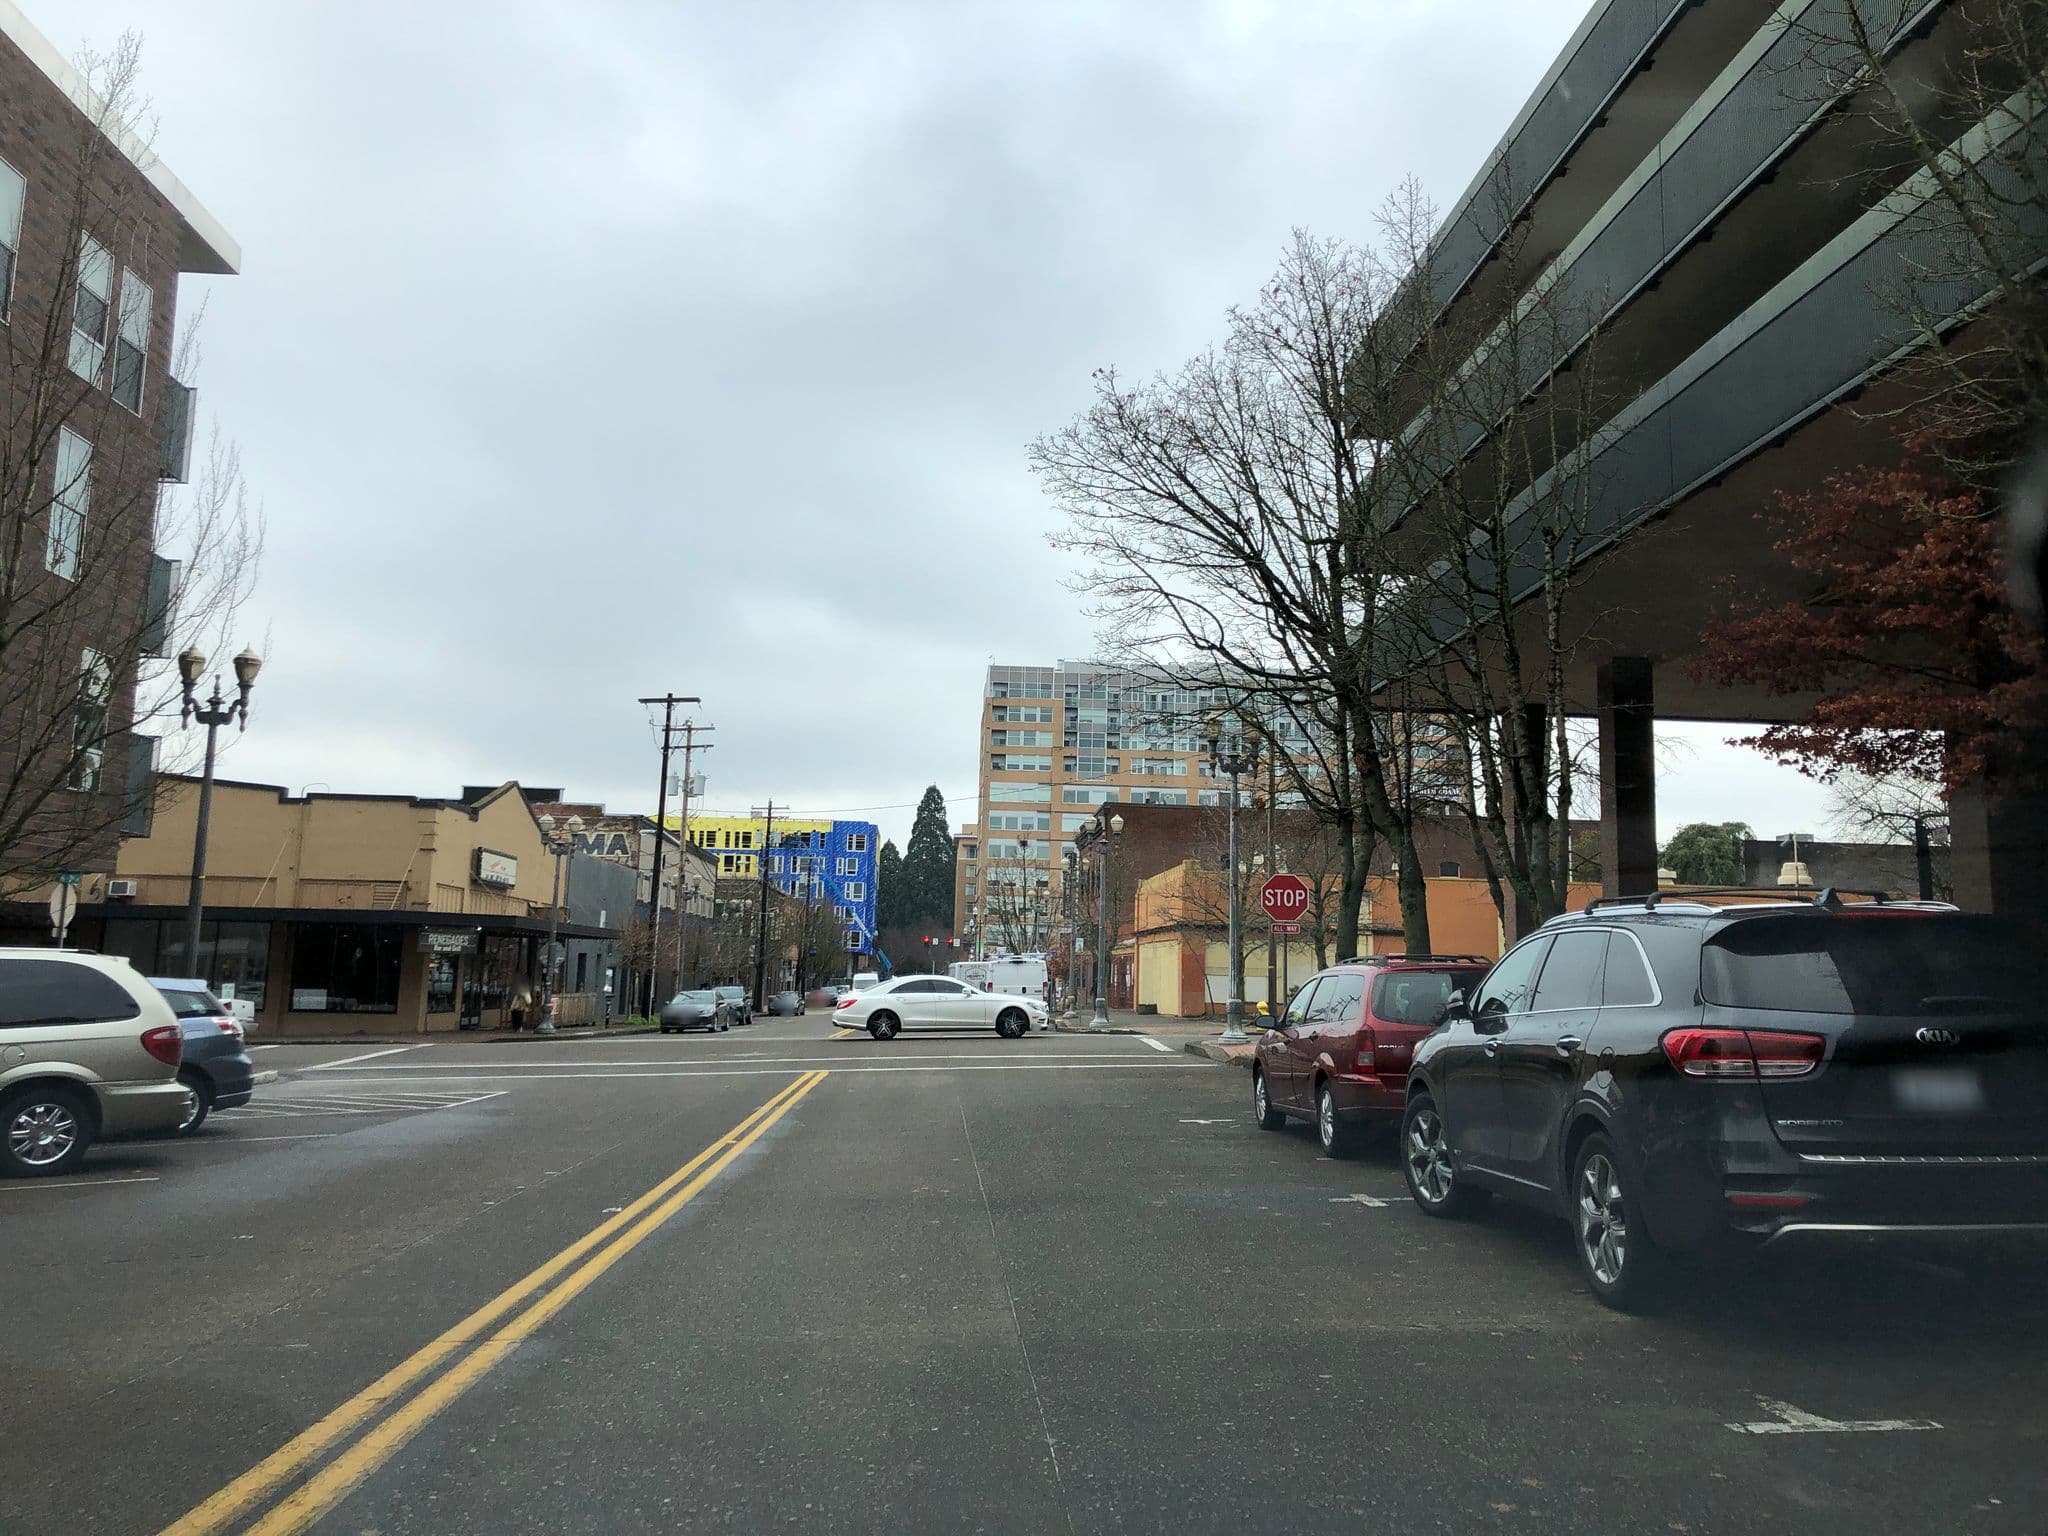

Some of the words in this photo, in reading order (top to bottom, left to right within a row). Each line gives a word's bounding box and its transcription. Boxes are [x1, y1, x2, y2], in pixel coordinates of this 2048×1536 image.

[1264, 888, 1306, 907] STOP
[428, 933, 469, 946] RENEGADES
[1921, 1029, 1953, 1043] KIA
[1777, 1119, 1844, 1127] SORENTO
